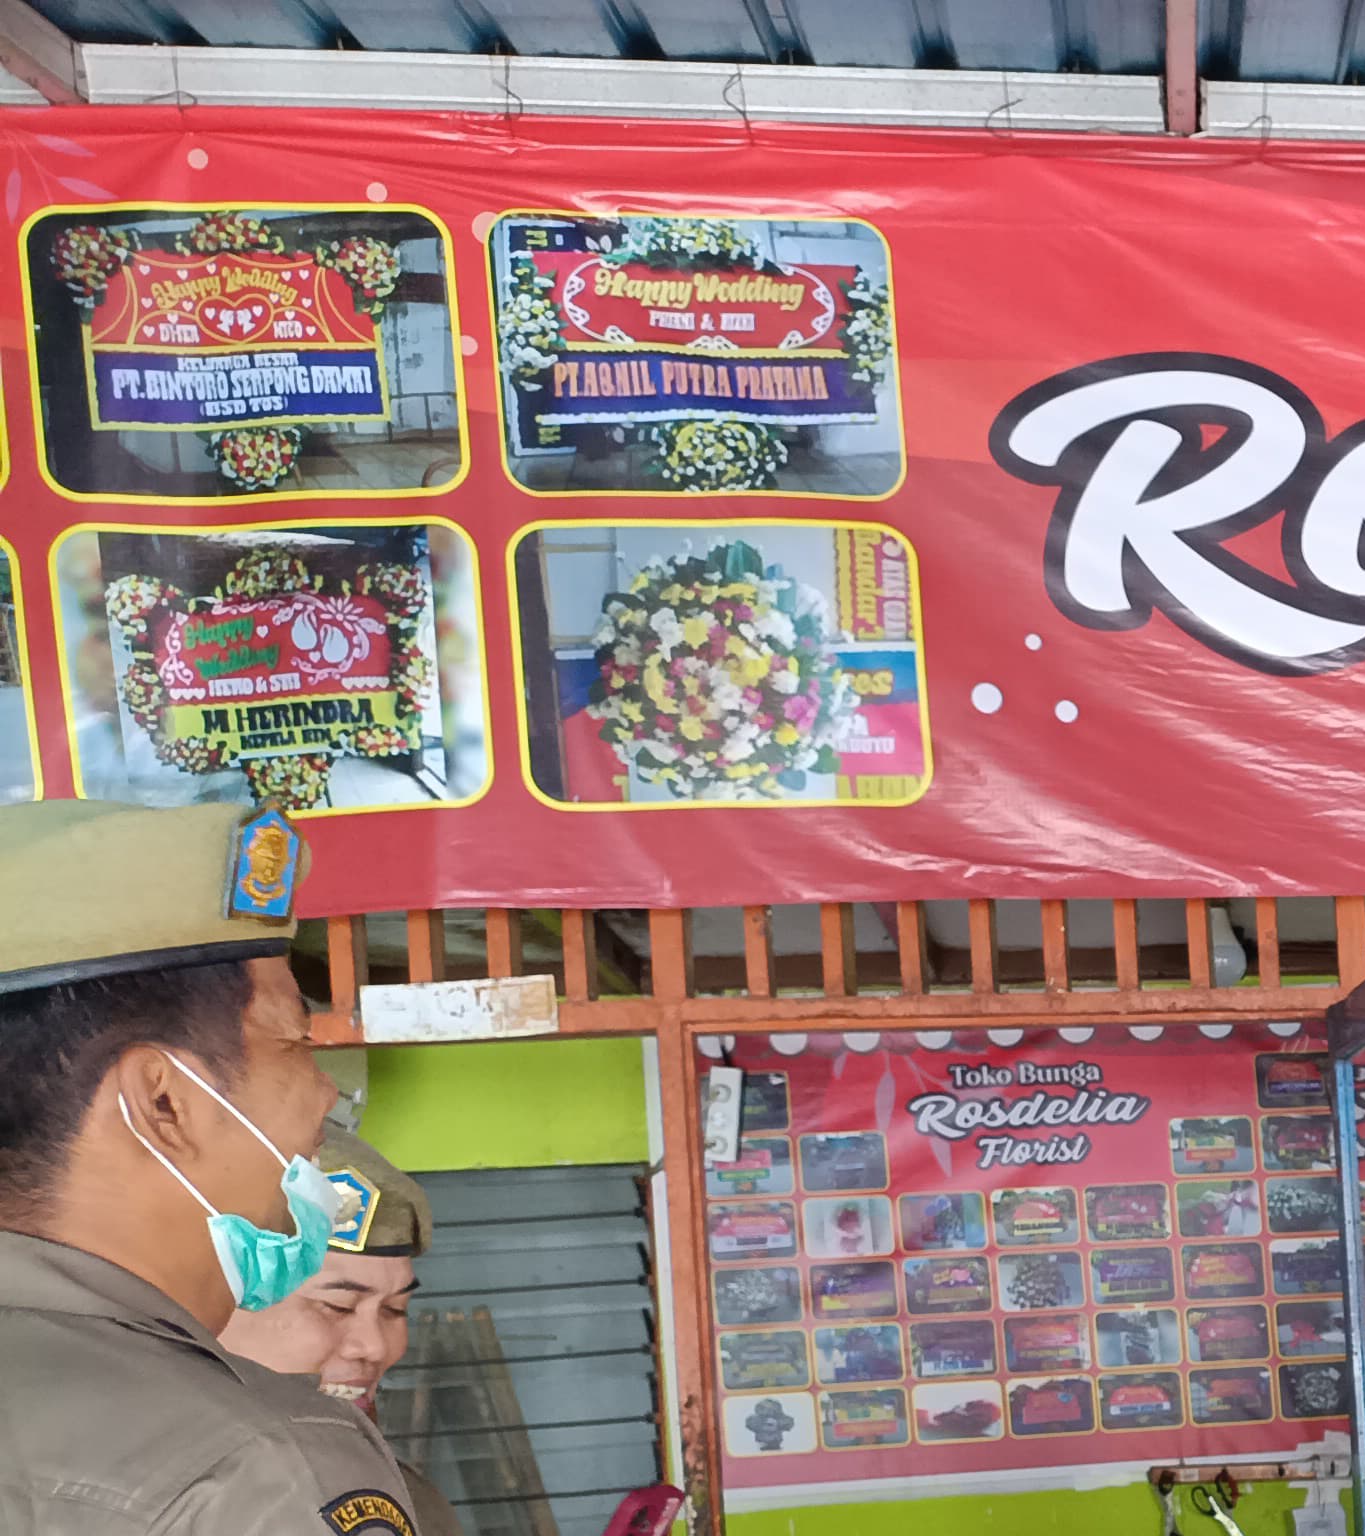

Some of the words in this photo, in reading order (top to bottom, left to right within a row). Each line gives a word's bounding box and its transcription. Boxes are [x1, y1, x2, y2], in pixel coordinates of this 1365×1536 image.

[594, 268, 692, 309] Happy
[949, 1064, 1013, 1087] Toko
[1017, 1062, 1101, 1087] Bunga
[909, 1090, 1148, 1139] Rosdelia
[978, 1134, 1089, 1169] Florist
